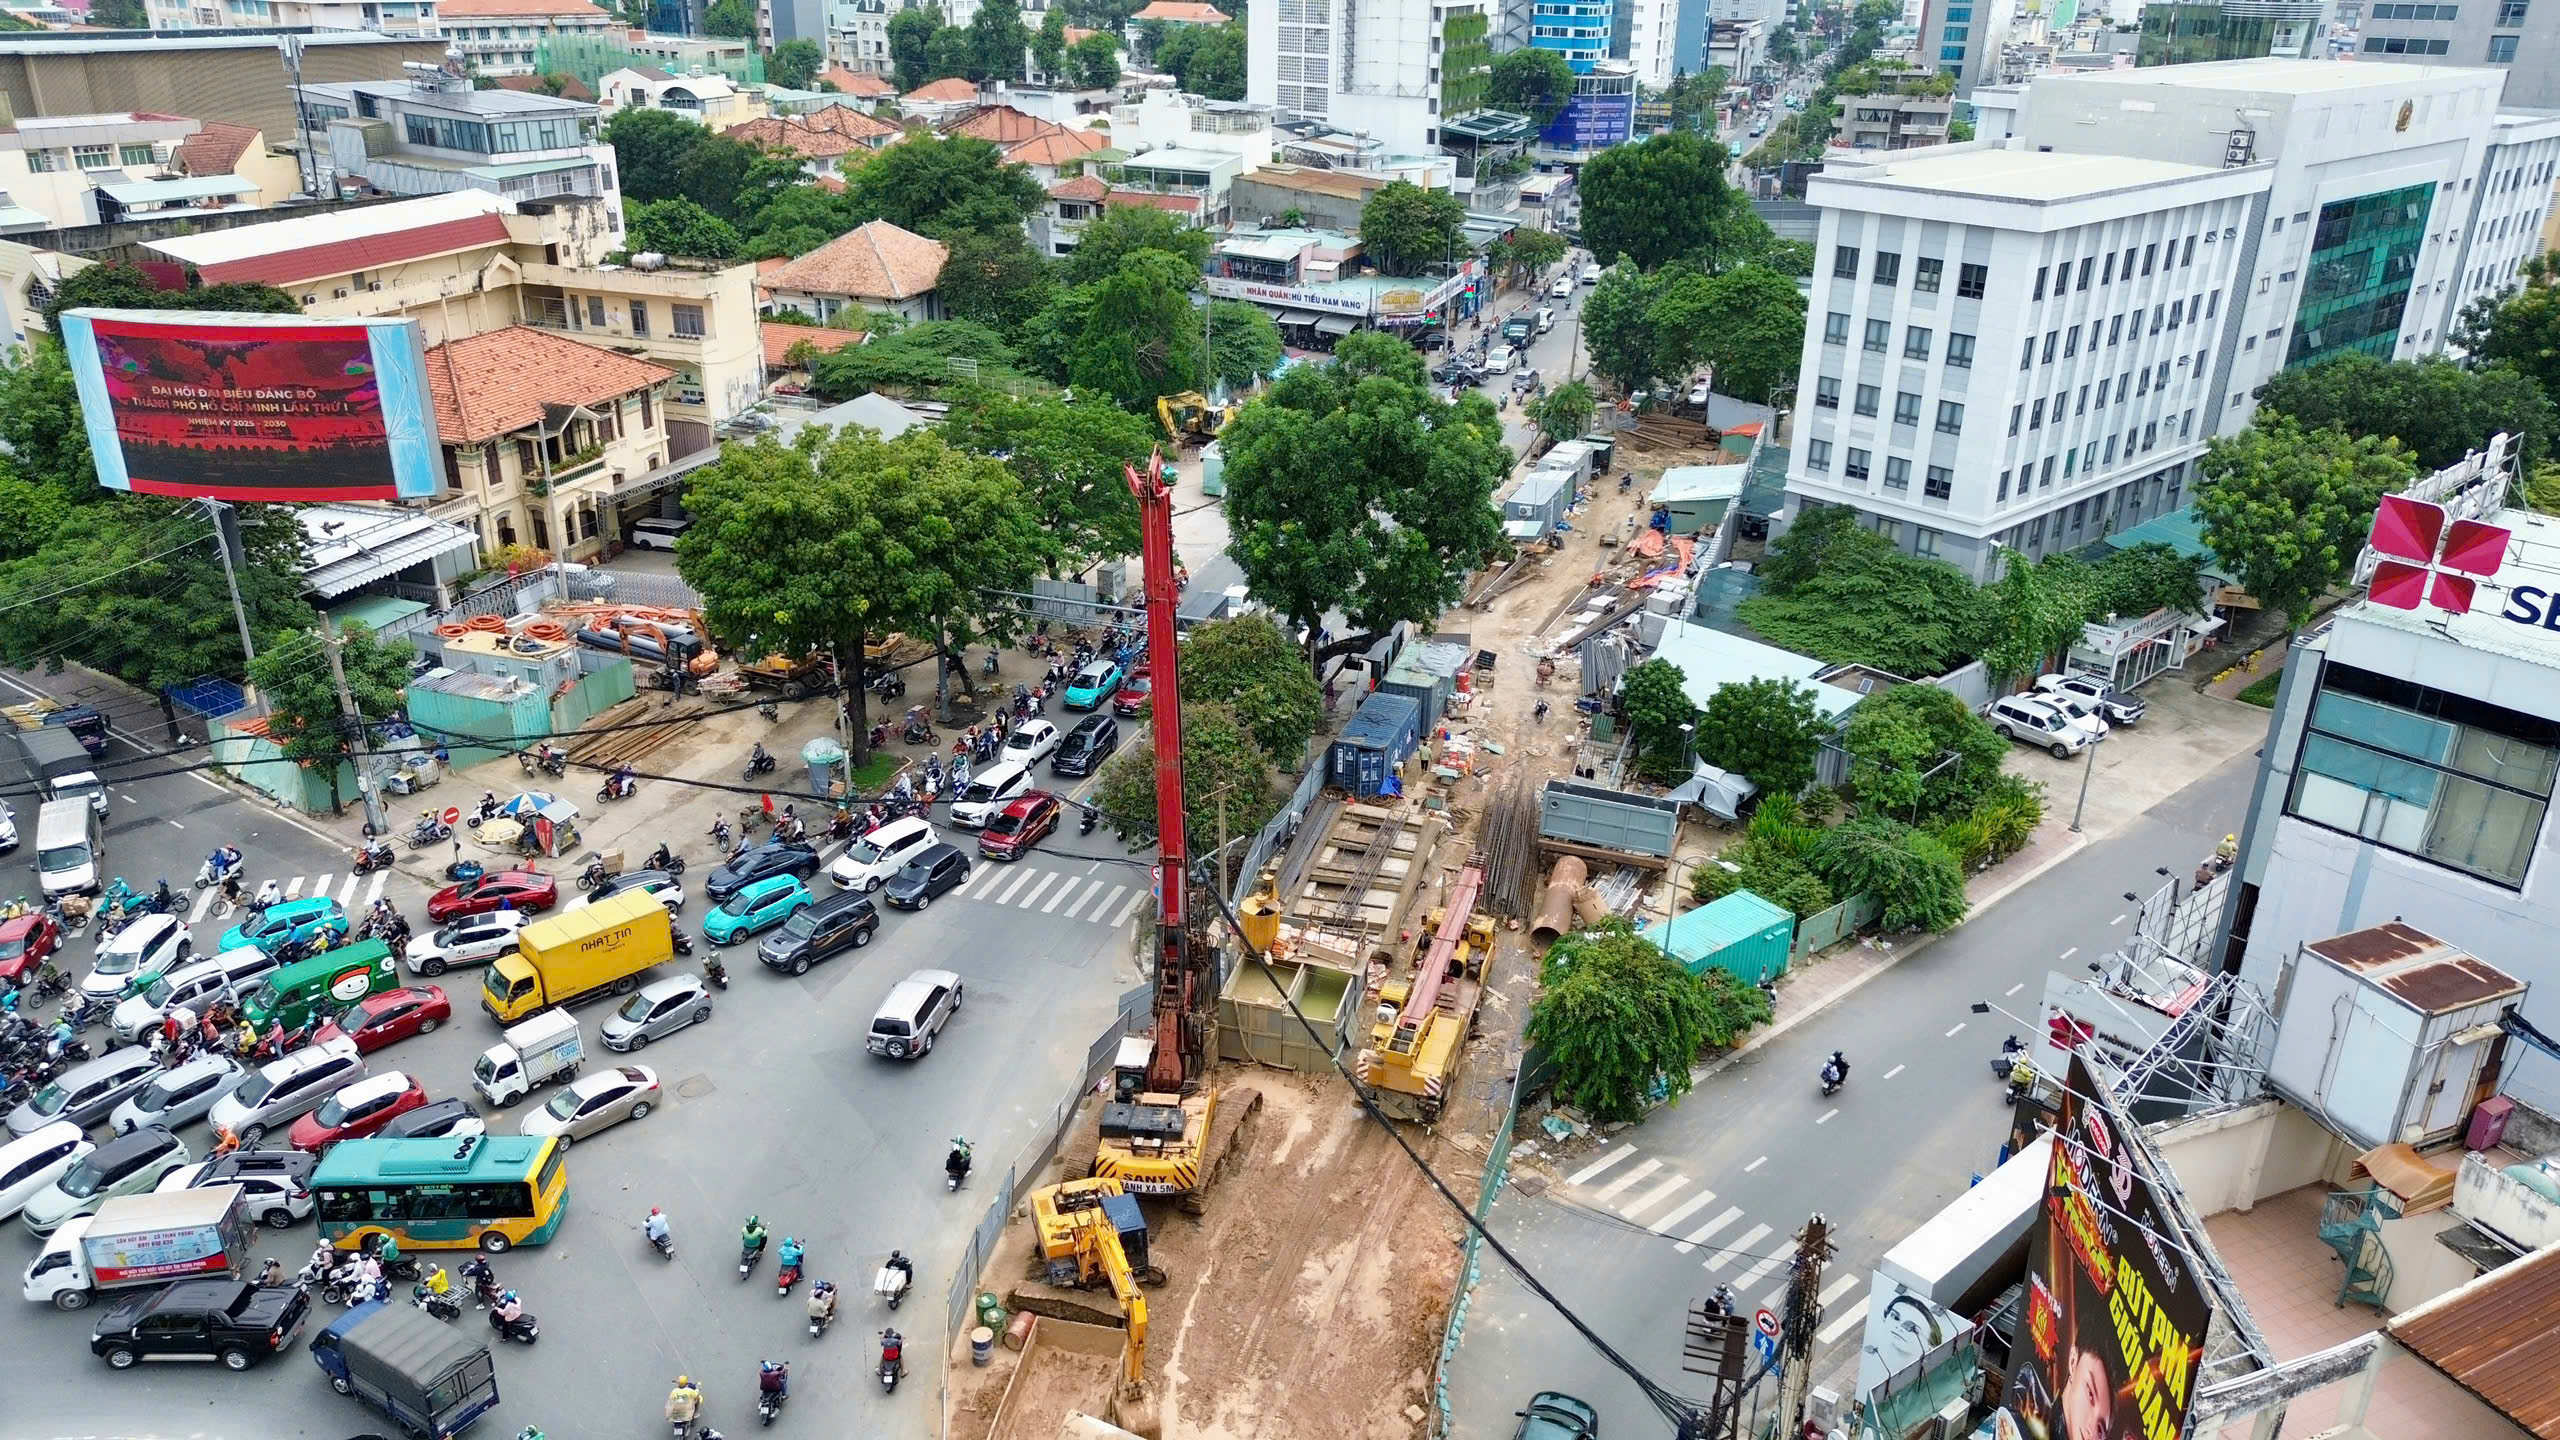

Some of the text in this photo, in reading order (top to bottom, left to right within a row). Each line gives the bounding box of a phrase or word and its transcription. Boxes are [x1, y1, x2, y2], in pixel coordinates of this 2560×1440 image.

[1246, 287, 1267, 297] NHÂN
[1269, 288, 1289, 299] QUÁN
[1322, 296, 1339, 306] NAM
[1341, 298, 1361, 309] VANG
[246, 401, 280, 412] MINH
[232, 419, 255, 427] 2025
[263, 420, 287, 428] 2030
[1123, 1173, 1168, 1184] SANY
[1146, 1184, 1157, 1193] XA
[1160, 1185, 1174, 1193] 5M
[2109, 1289, 2144, 1381] GIỚI
[2117, 1254, 2190, 1412] BÚT PHÁ
